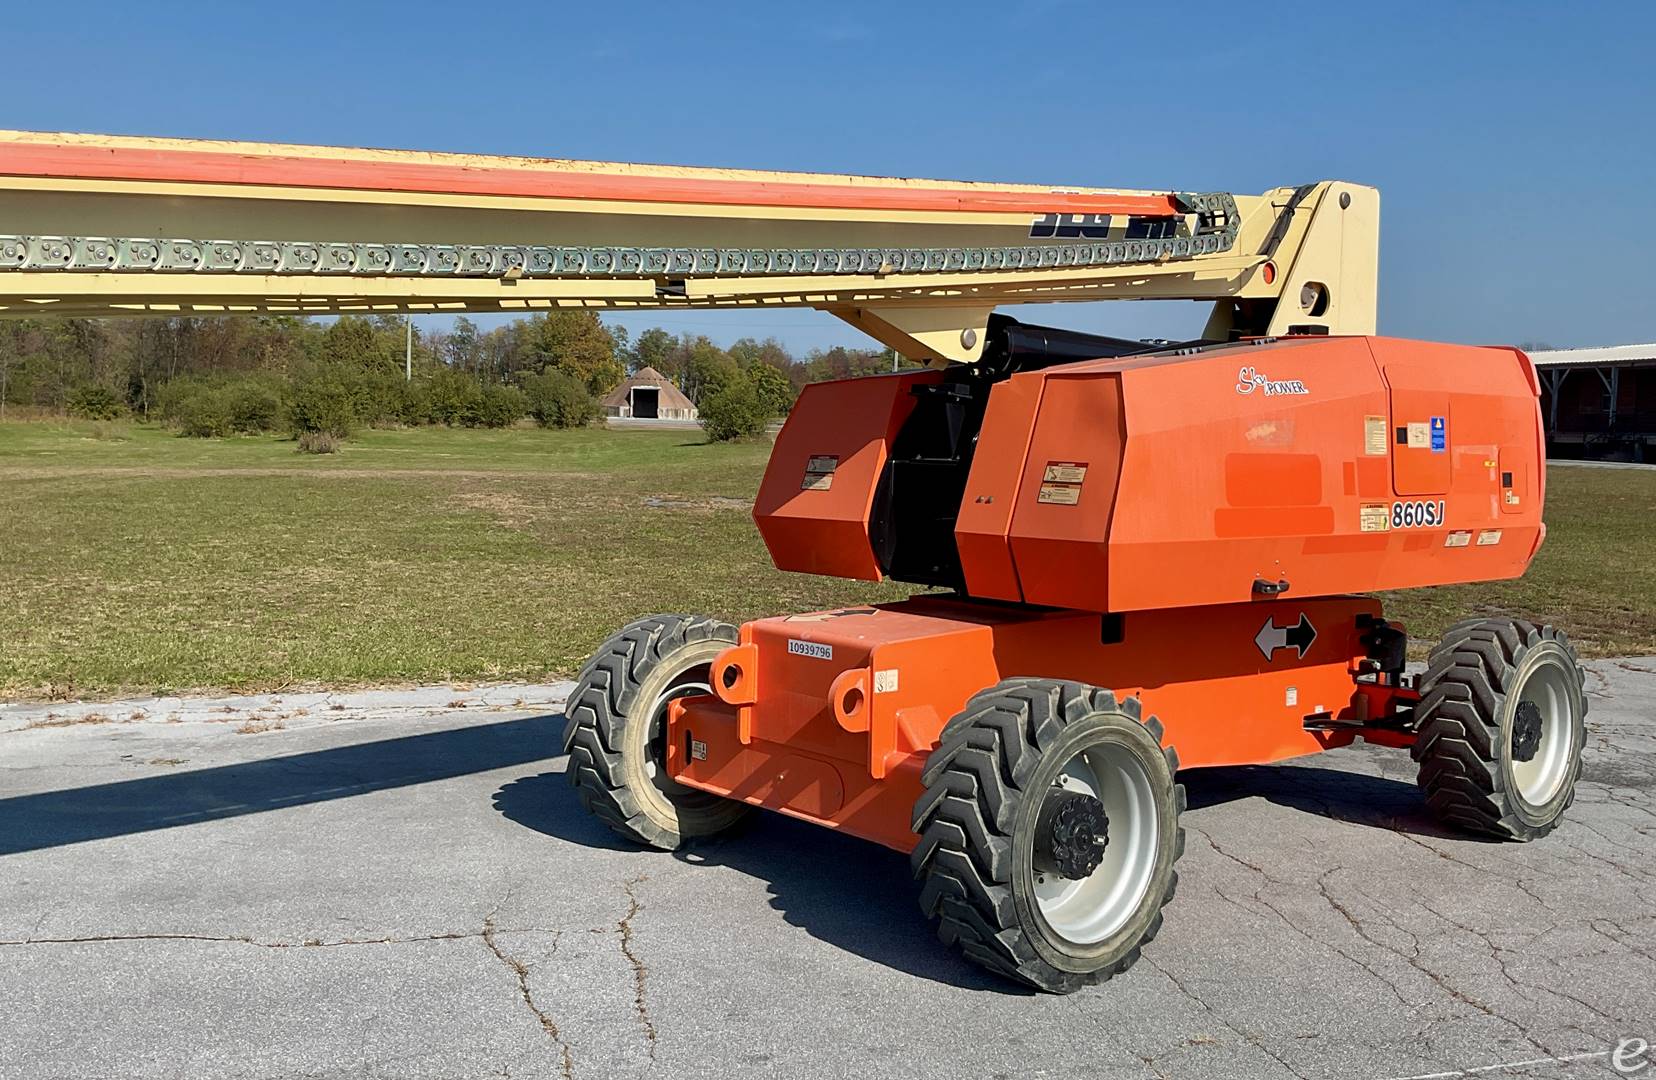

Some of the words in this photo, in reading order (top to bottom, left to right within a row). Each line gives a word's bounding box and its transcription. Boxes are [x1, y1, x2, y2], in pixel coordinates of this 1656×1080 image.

[1236, 366, 1268, 396] Sky
[1266, 380, 1309, 395] POWER
[1392, 501, 1445, 528] 860SJ
[789, 641, 831, 658] 10939796
